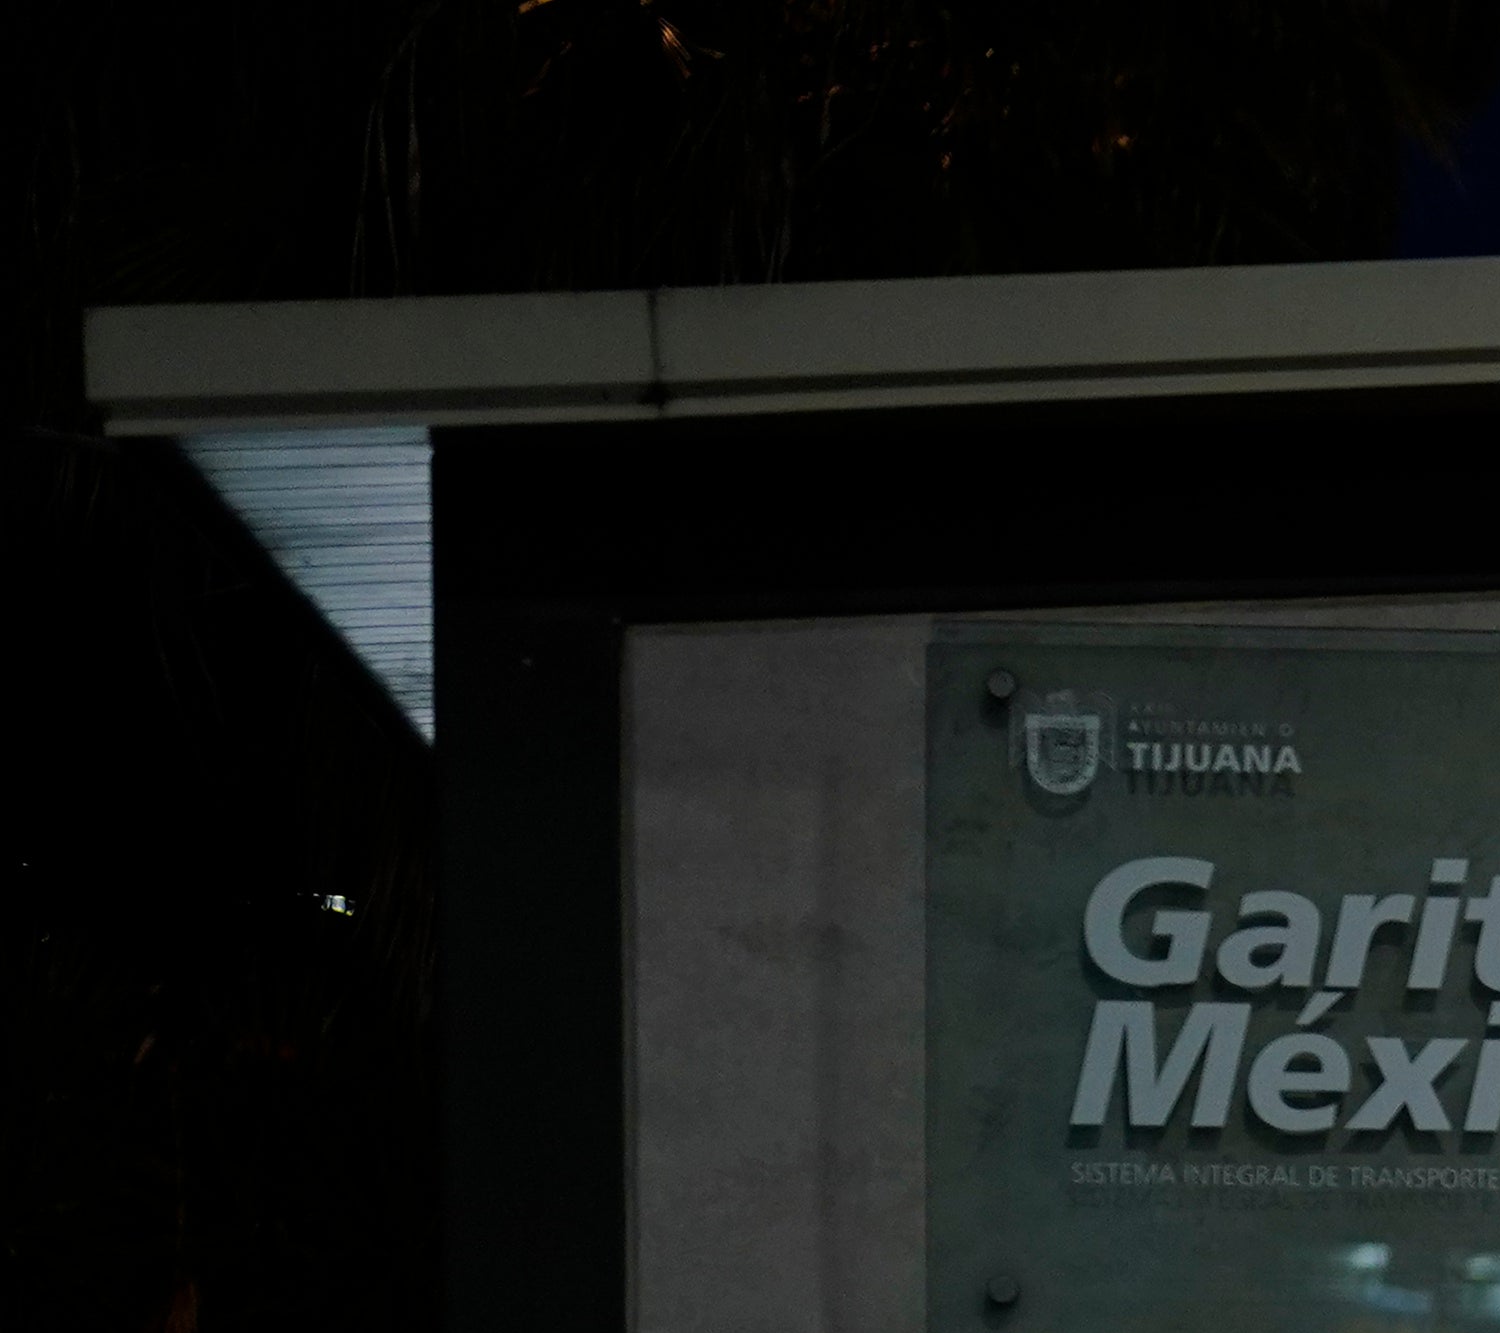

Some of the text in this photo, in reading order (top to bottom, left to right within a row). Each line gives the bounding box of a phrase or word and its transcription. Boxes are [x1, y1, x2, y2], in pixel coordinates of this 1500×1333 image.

[1127, 721, 1296, 738] AYUNTAMIENO
[1127, 742, 1302, 774] TIJUANA
[1070, 1162, 1175, 1187] SISTEMA
[1183, 1163, 1299, 1188] INTEGRAL
[1308, 1165, 1338, 1188] DE
[1348, 1165, 1500, 1190] TRANSPORTE
